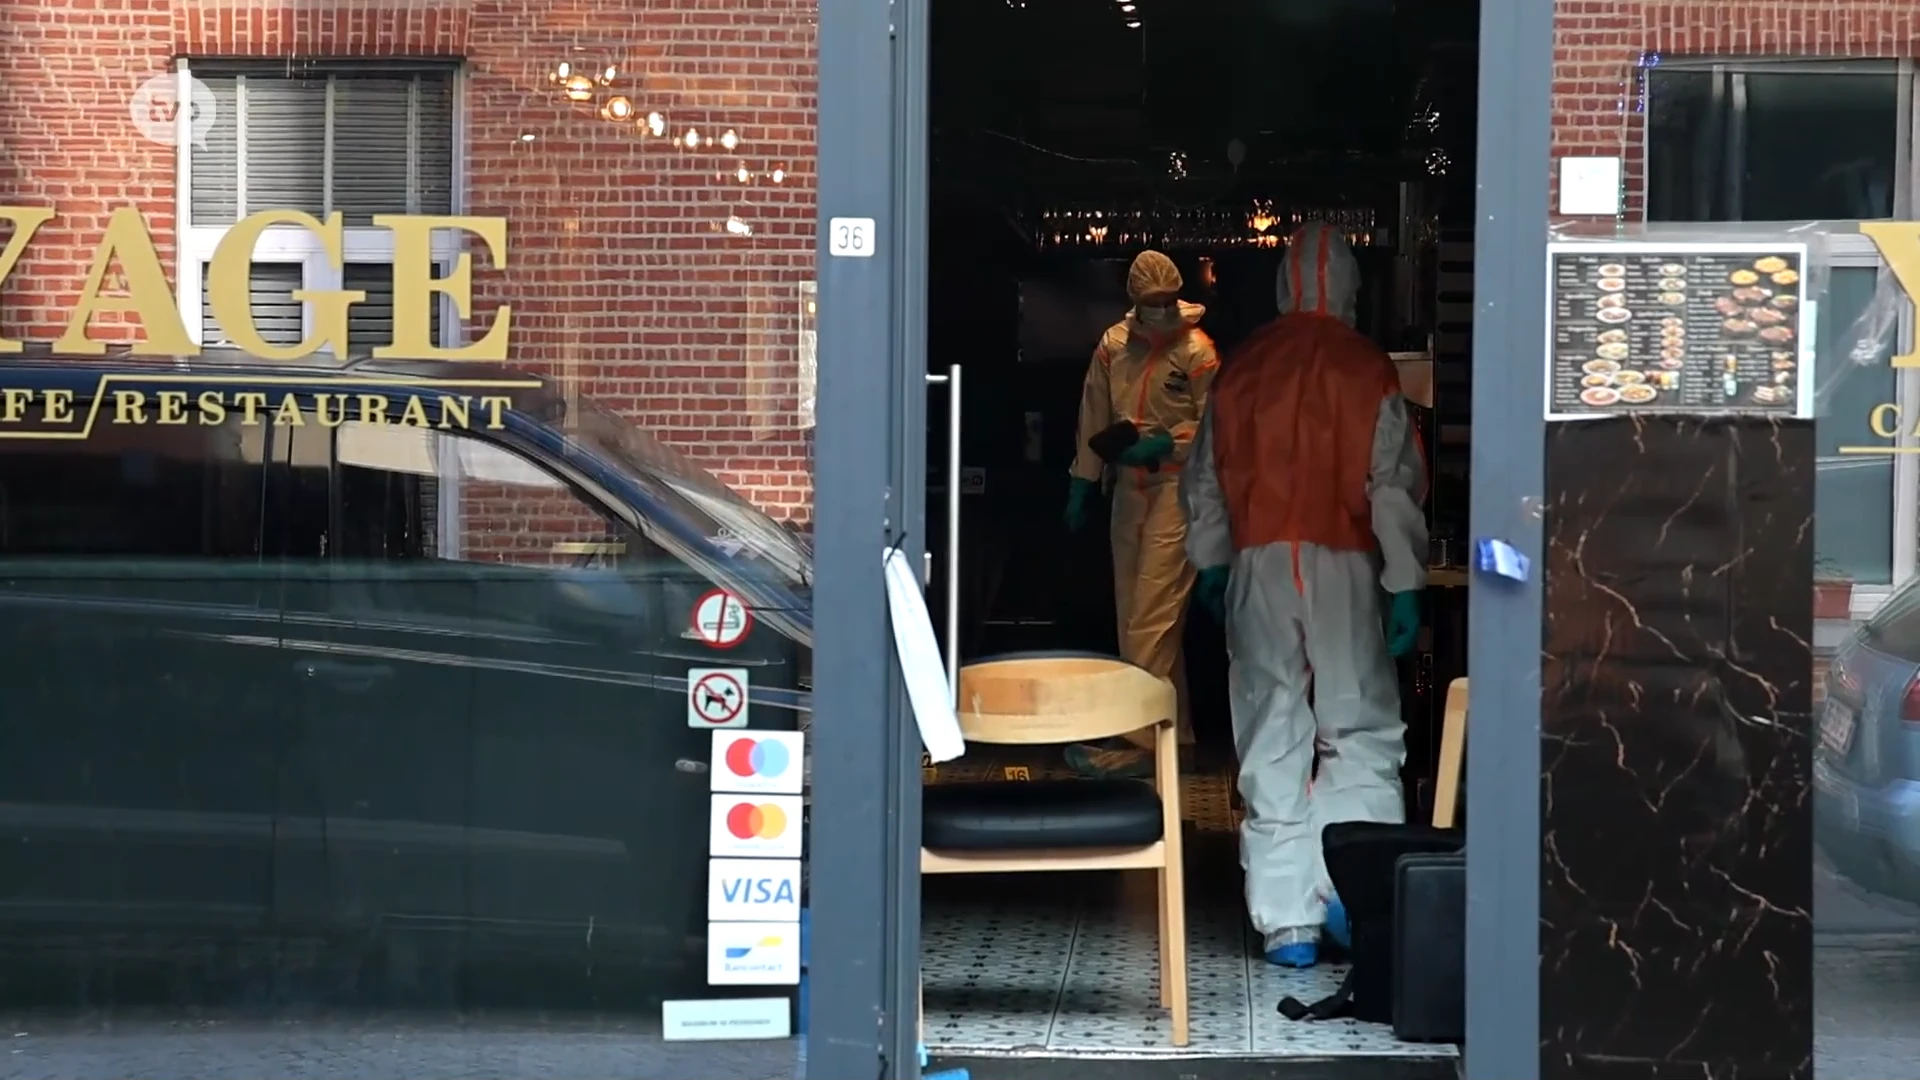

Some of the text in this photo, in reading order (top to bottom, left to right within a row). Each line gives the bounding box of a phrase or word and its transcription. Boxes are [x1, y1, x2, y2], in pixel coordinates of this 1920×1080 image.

[838, 225, 863, 250] 36
[112, 390, 512, 430] RESTAURANT
[1870, 403, 1920, 437] C
[721, 878, 794, 904] VISA
